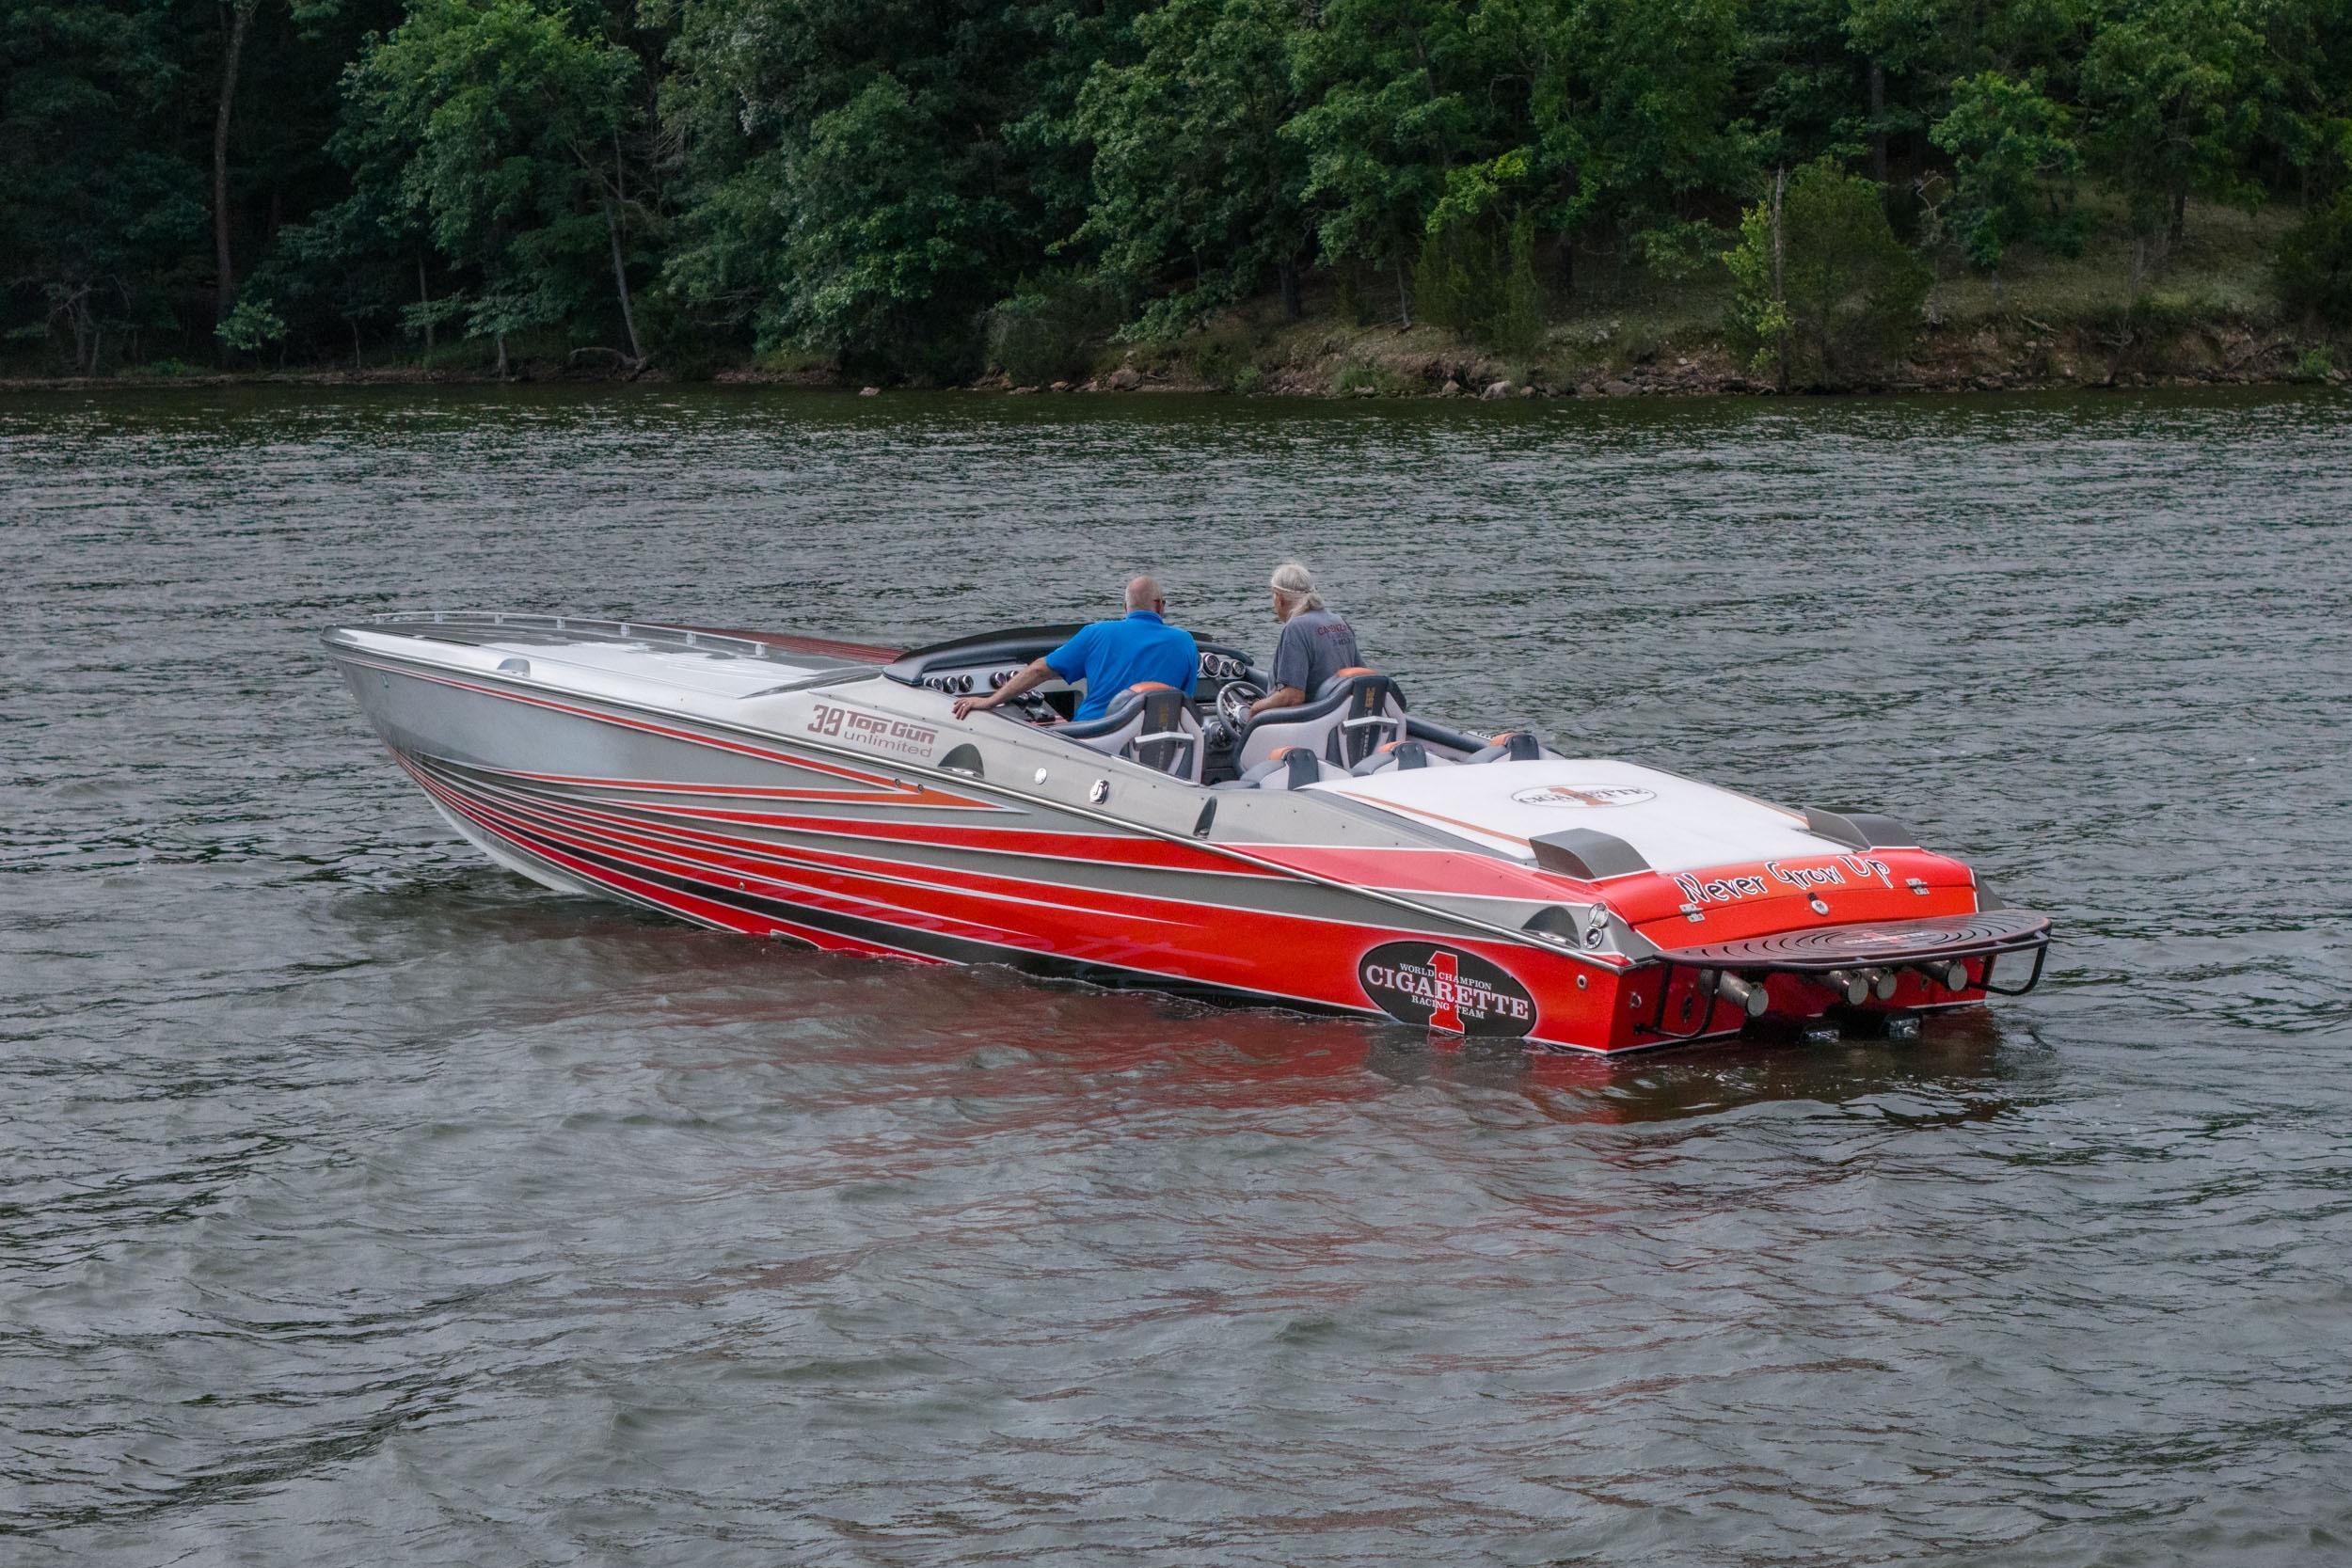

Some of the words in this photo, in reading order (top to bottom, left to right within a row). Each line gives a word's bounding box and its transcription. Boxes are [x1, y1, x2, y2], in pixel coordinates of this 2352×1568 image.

[807, 704, 846, 736] 39
[847, 710, 893, 735] Top
[890, 721, 939, 744] Gun
[844, 731, 932, 758] unlimited
[1674, 873, 1769, 904] Never
[1765, 861, 1846, 891] Grow
[1836, 854, 1895, 890] Up
[1366, 964, 1530, 1021] CIGARETTE
[1399, 962, 1435, 978] WORLD
[1438, 972, 1492, 991] CHAMPION
[1411, 994, 1451, 1012] RACING
[1454, 1005, 1486, 1020] TEAM
